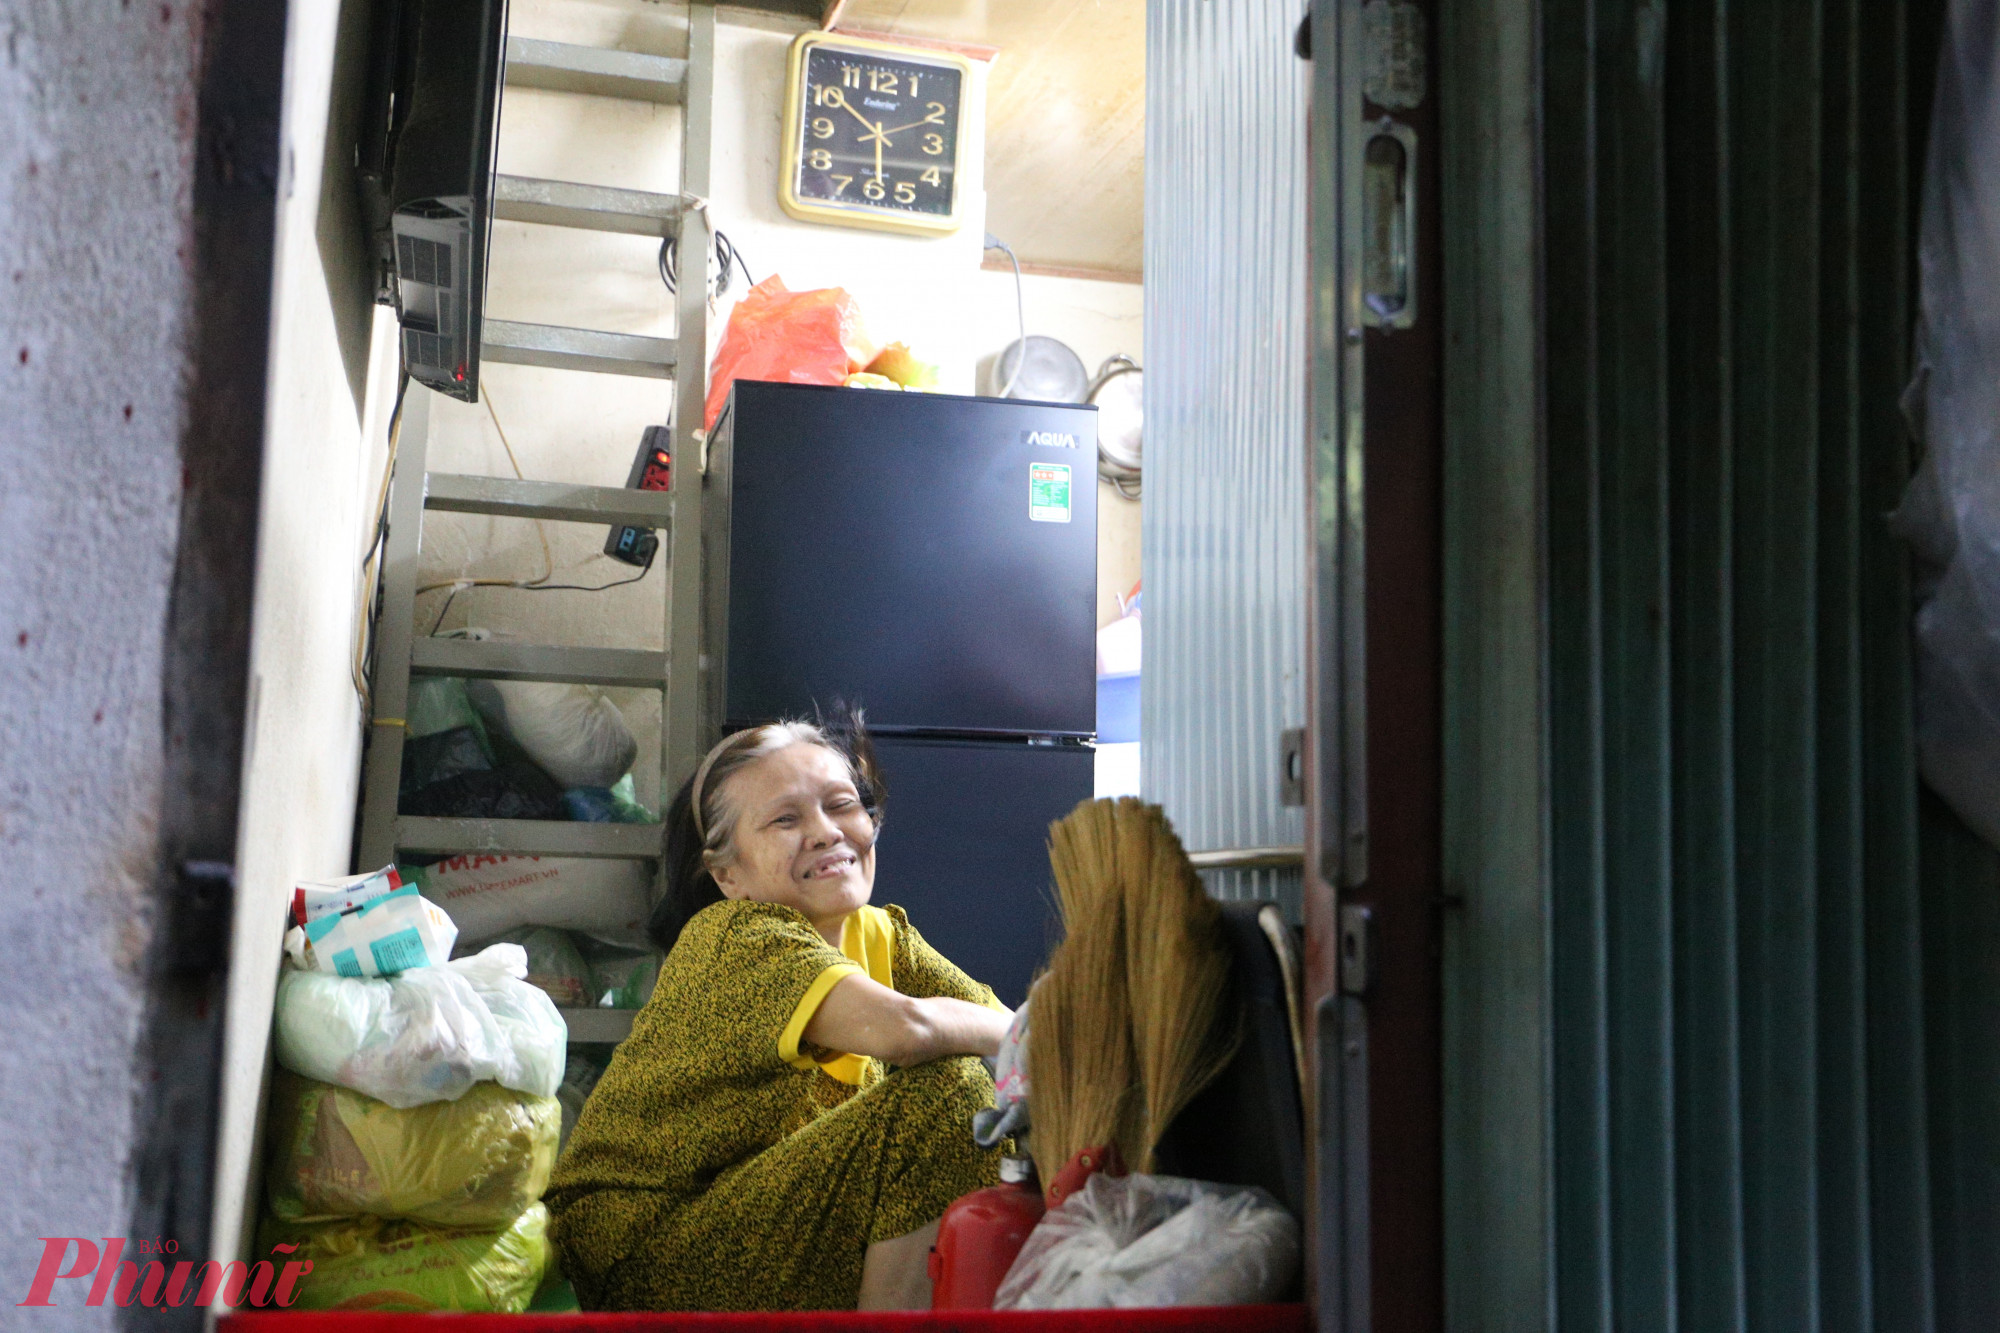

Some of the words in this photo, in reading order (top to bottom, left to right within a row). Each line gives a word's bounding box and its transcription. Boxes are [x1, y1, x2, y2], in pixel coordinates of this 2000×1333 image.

[841, 65, 861, 90] 11
[868, 70, 898, 95] 12
[908, 75, 919, 98] 1
[812, 84, 845, 108] 10
[925, 101, 946, 125] 2
[812, 117, 835, 139] 9
[922, 133, 943, 155] 3
[809, 148, 832, 171] 8
[831, 174, 853, 196] 7
[920, 165, 941, 187] 4
[863, 179, 885, 200] 6
[894, 182, 916, 204] 5
[1027, 431, 1076, 449] AQUA
